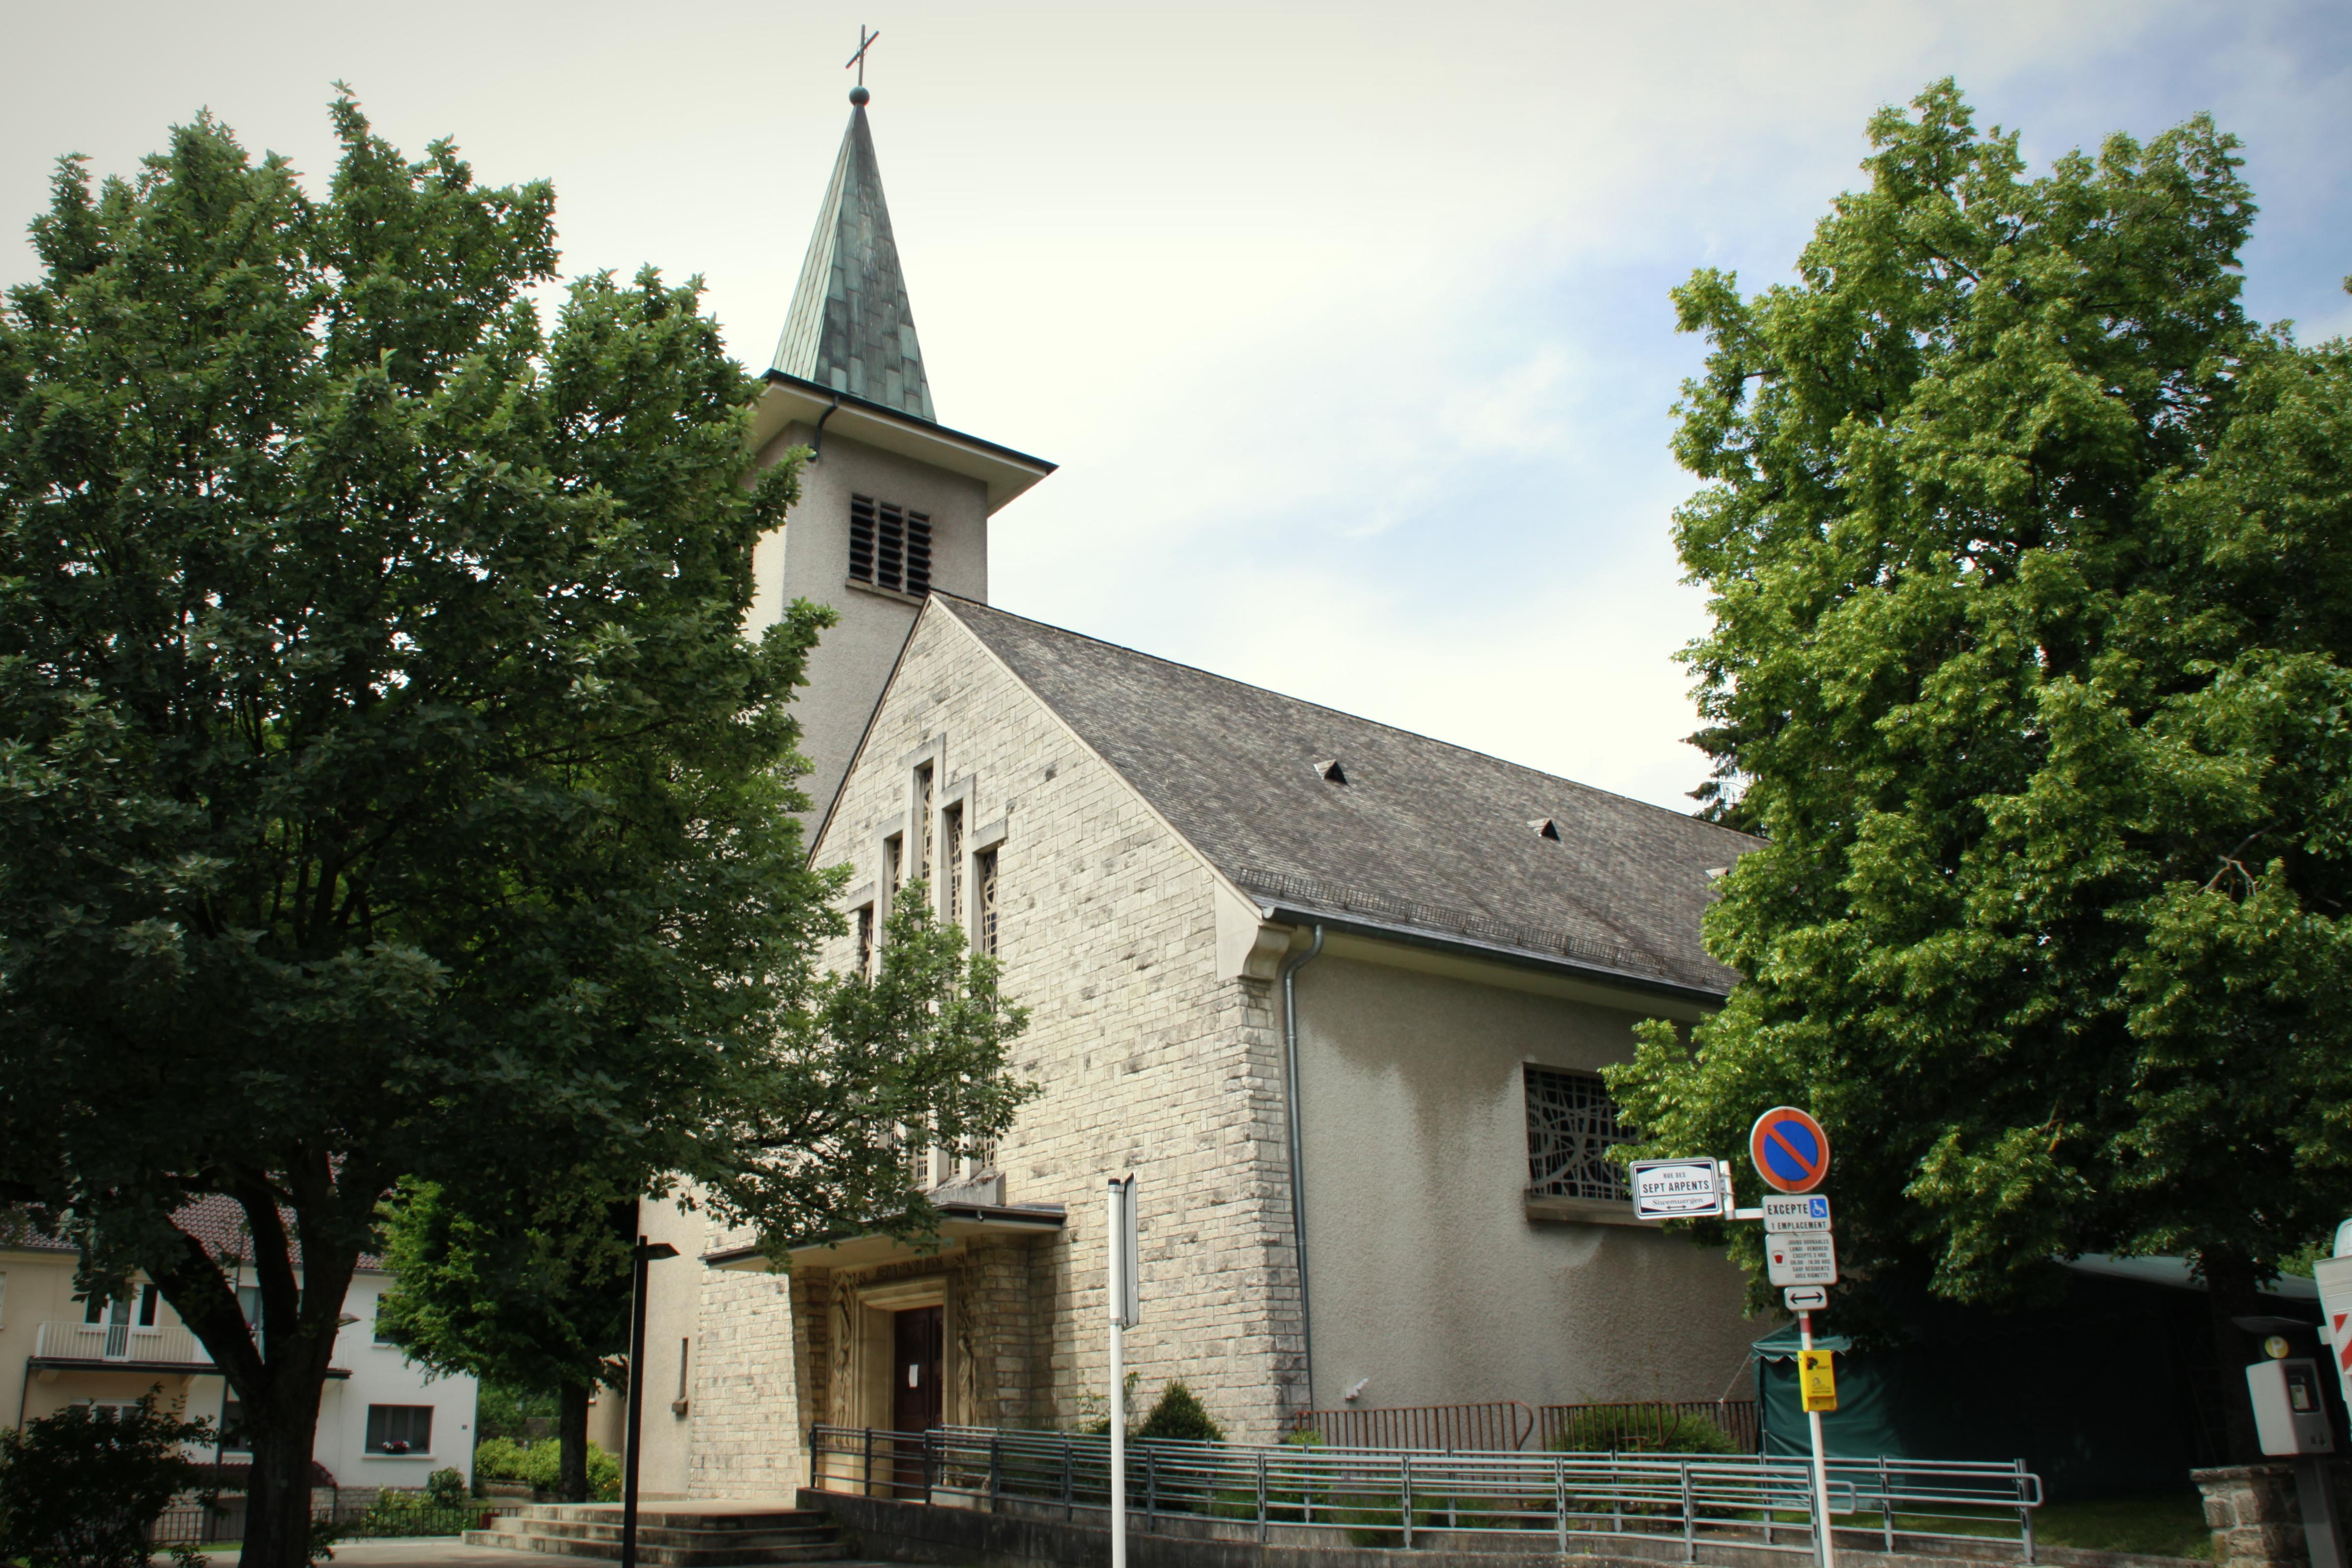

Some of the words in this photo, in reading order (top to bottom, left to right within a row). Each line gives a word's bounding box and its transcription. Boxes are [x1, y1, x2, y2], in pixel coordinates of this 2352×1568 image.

[1643, 1183, 1665, 1193] SEPT
[1668, 1180, 1710, 1192] ARPENTS
[1767, 1204, 1808, 1215] EXCEPTE
[1777, 1221, 1826, 1229] EMPLACEMENT
[2269, 1337, 2283, 1356] P
